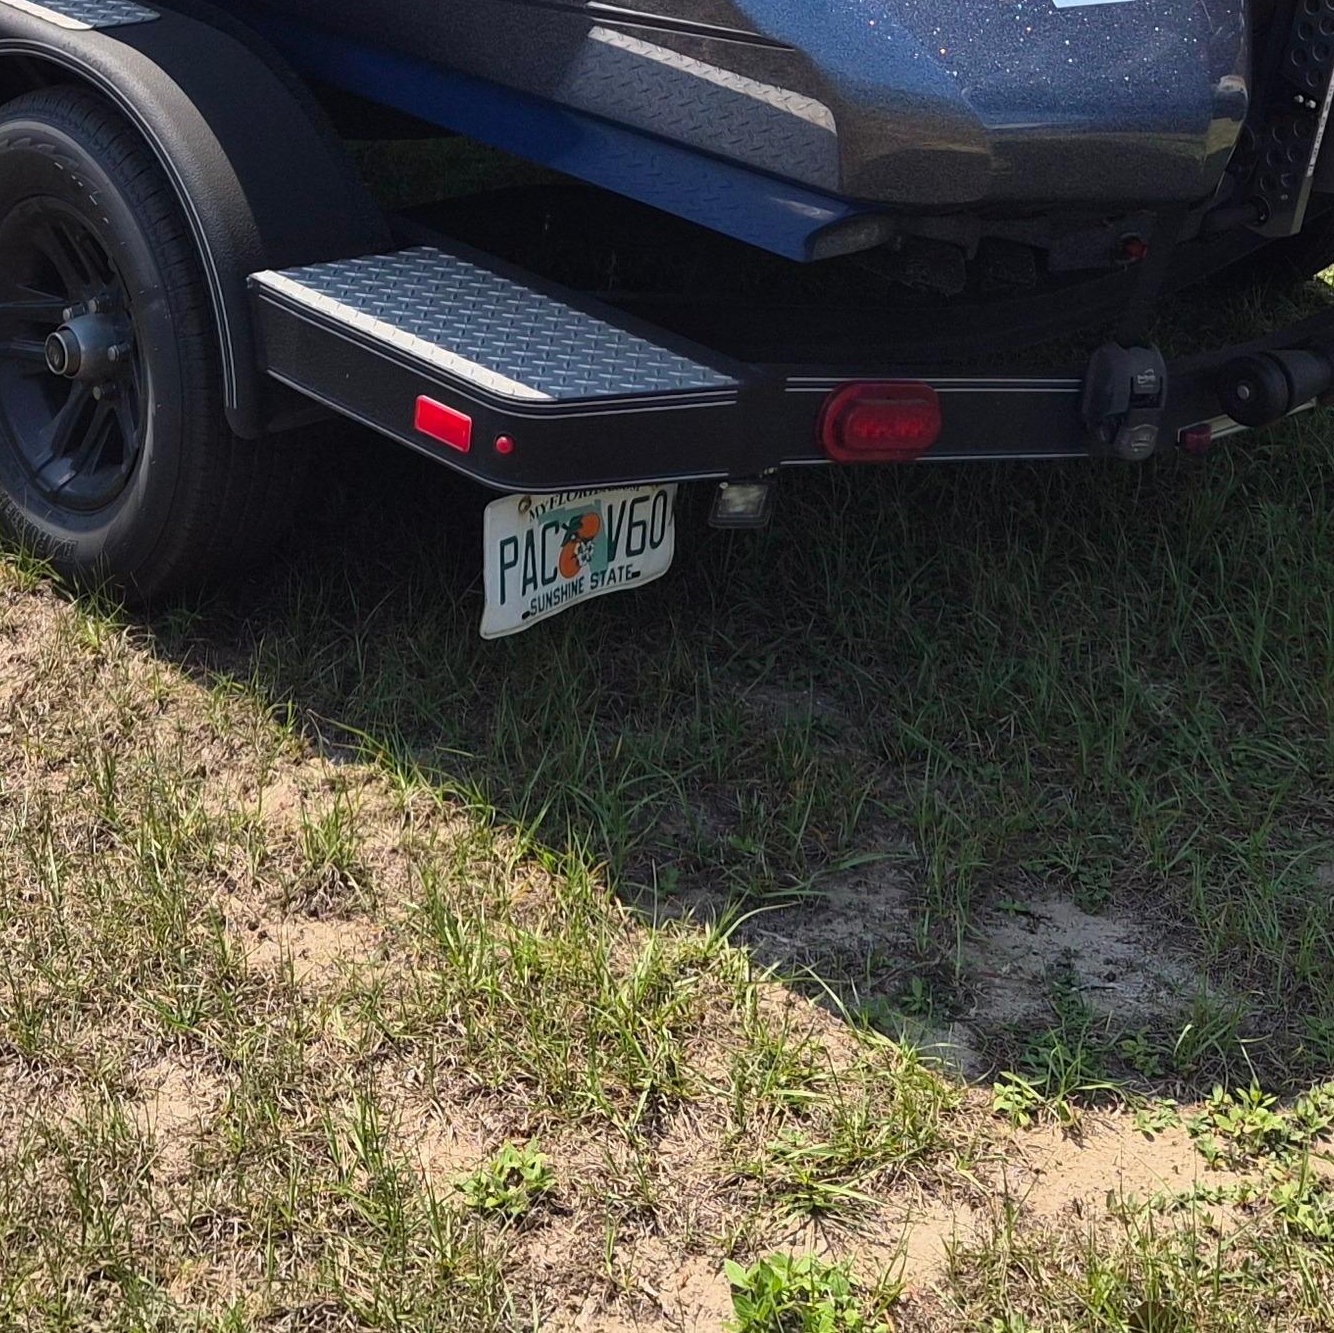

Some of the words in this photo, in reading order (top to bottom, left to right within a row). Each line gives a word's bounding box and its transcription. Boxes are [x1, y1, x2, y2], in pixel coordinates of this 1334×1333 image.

[499, 520, 561, 606] PAC
[607, 489, 668, 563] V60
[530, 580, 585, 616] SUNSHINE
[590, 564, 633, 591] STATE
